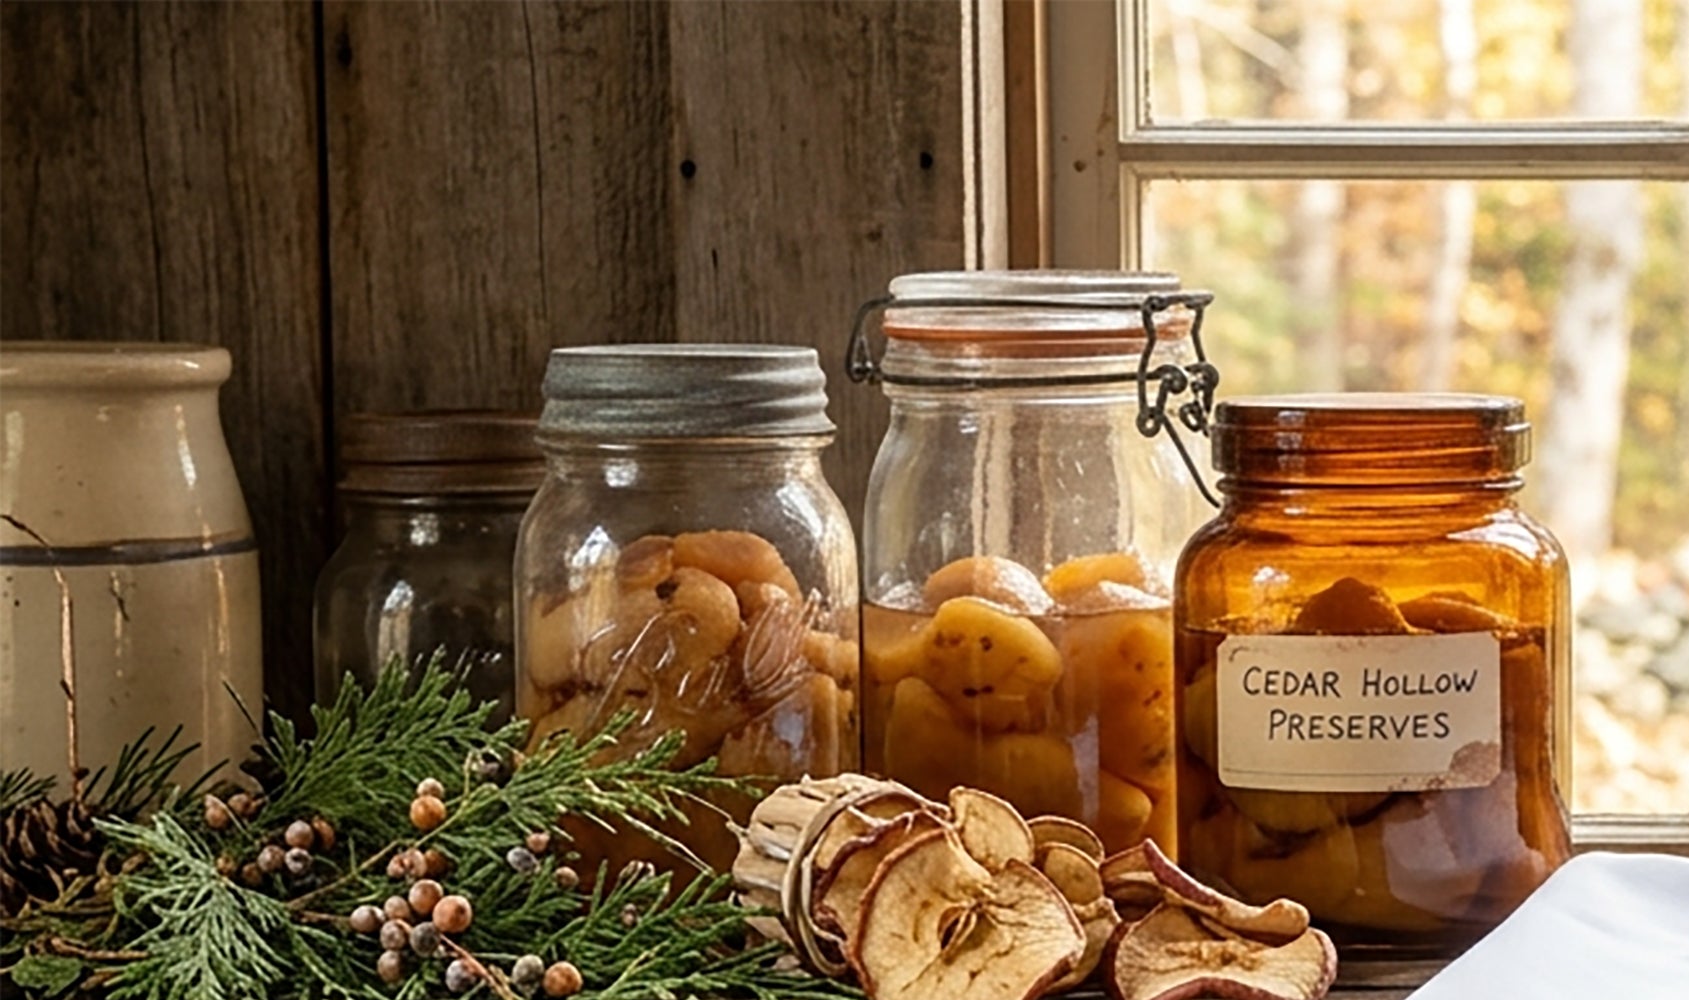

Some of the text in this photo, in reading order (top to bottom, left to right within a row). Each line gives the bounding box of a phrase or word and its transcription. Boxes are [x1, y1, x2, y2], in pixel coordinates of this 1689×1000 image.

[1244, 667, 1478, 698] CEDAR HOLLOW
[1268, 708, 1450, 740] PRESERVES
